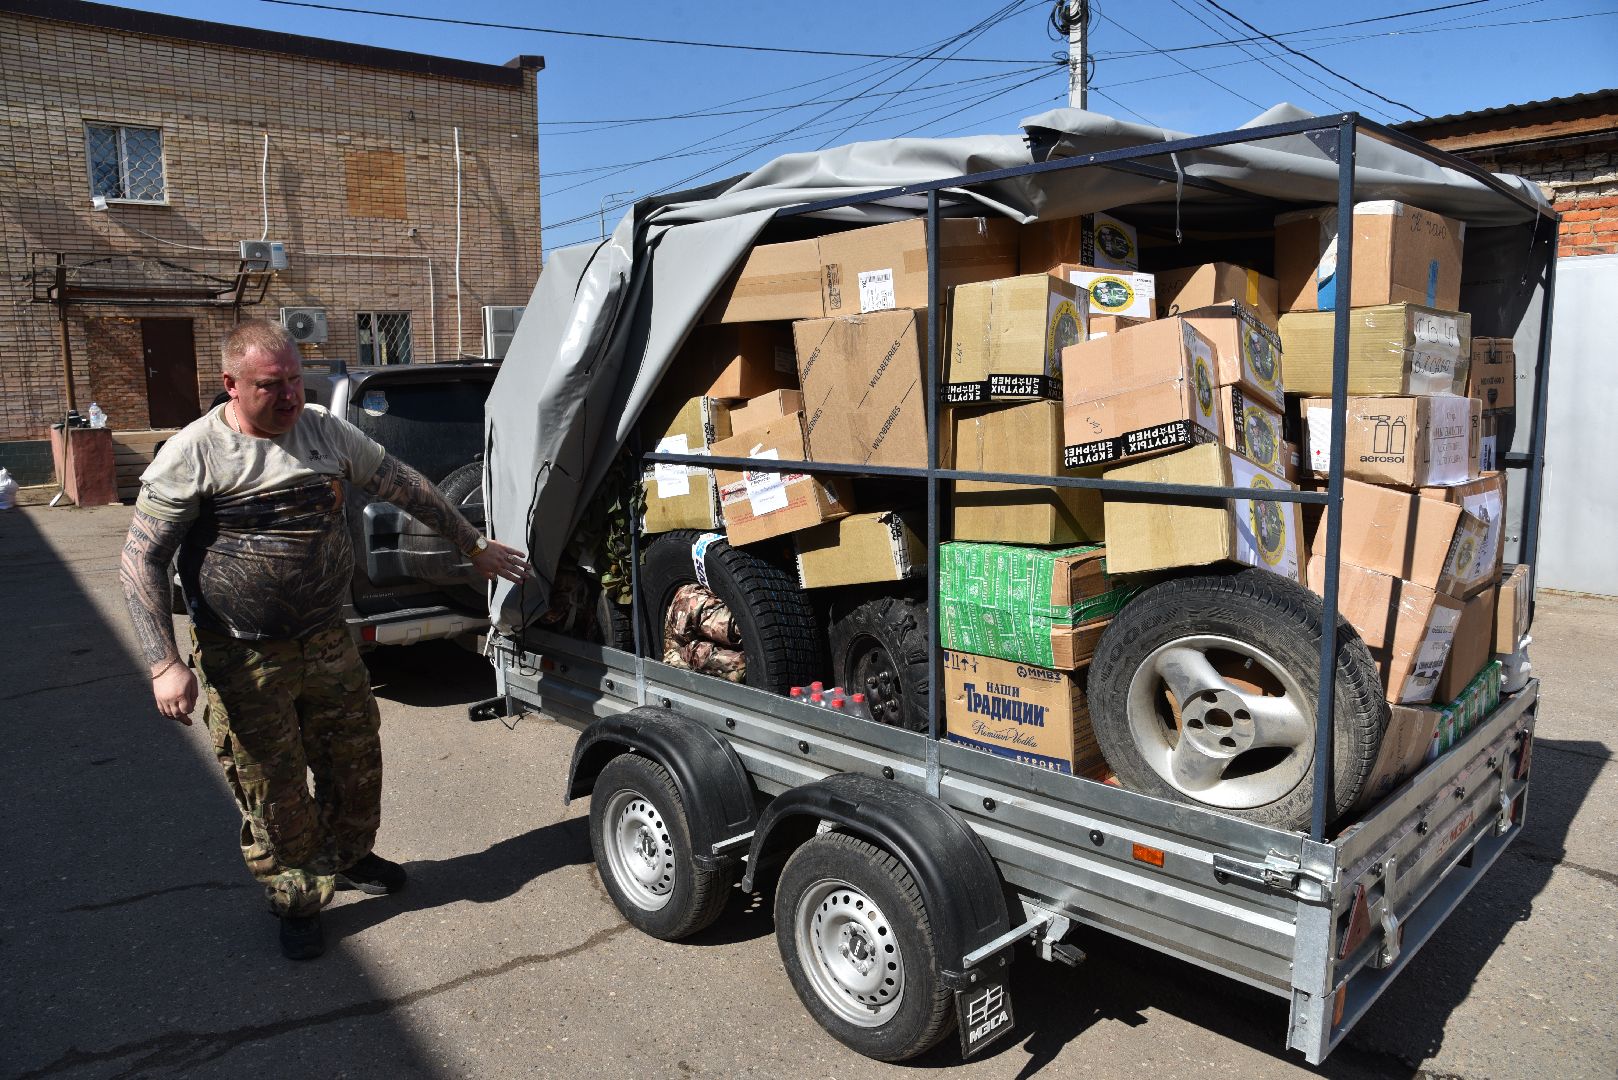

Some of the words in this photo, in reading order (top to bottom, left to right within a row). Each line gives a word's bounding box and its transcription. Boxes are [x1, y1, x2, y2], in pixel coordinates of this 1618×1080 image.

[869, 340, 901, 388] WILDBERRIES
[991, 385, 1032, 394] КРУТЫХ
[872, 405, 901, 450] WILDBERRIES
[1129, 435, 1177, 453] КРУТЫХ
[986, 681, 1020, 698] НАШИ
[971, 719, 1009, 741] Premium
[1008, 728, 1038, 748] Vodka
[1016, 755, 1061, 772] EXPORT
